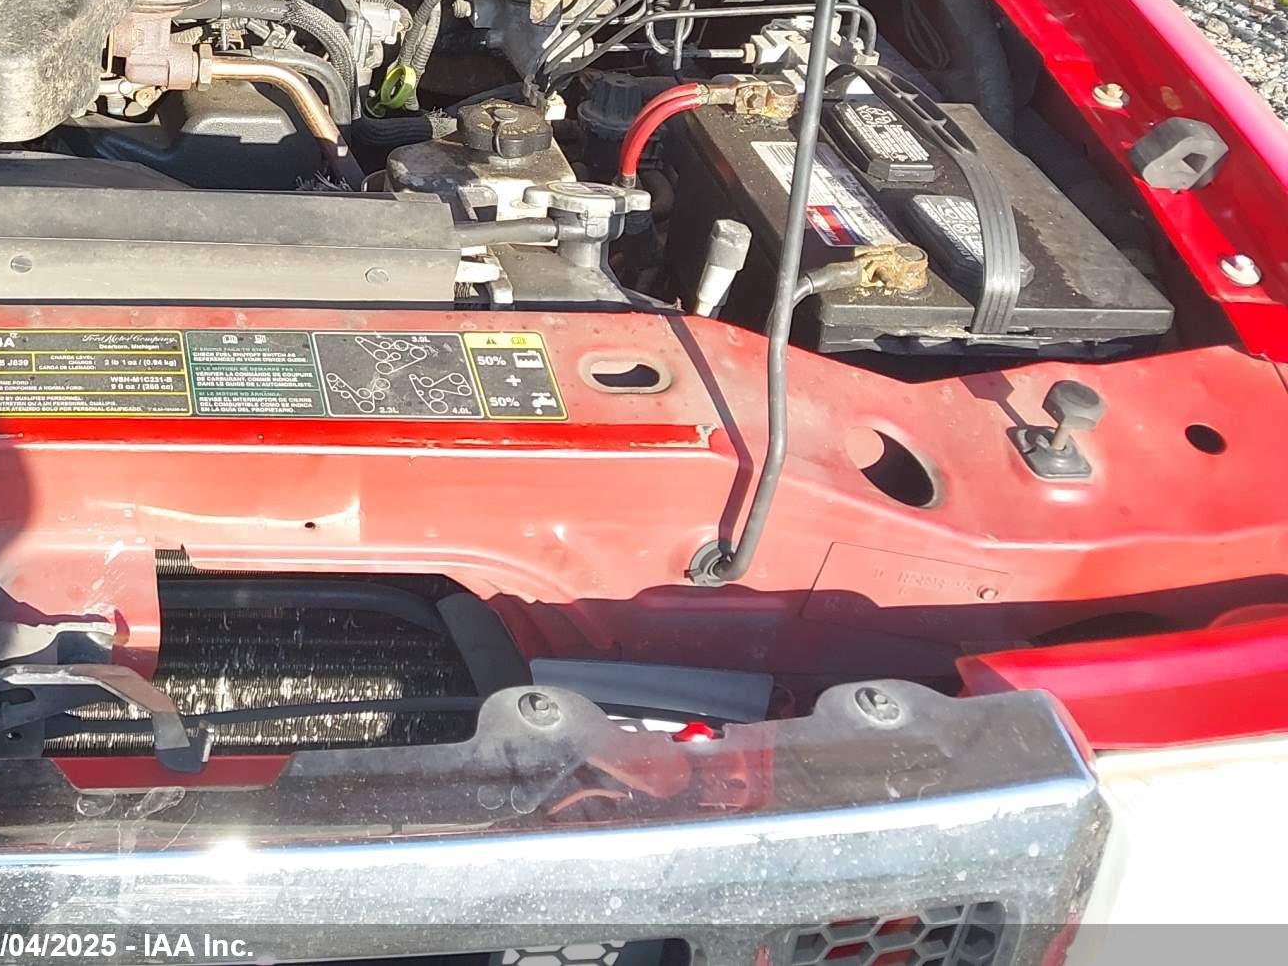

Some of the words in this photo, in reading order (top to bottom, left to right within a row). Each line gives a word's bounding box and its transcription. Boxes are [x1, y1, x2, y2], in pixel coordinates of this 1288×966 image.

[81, 335, 103, 344] Ford
[104, 335, 131, 344] Motor
[477, 356, 507, 367] 50%
[489, 397, 520, 408] 50%
